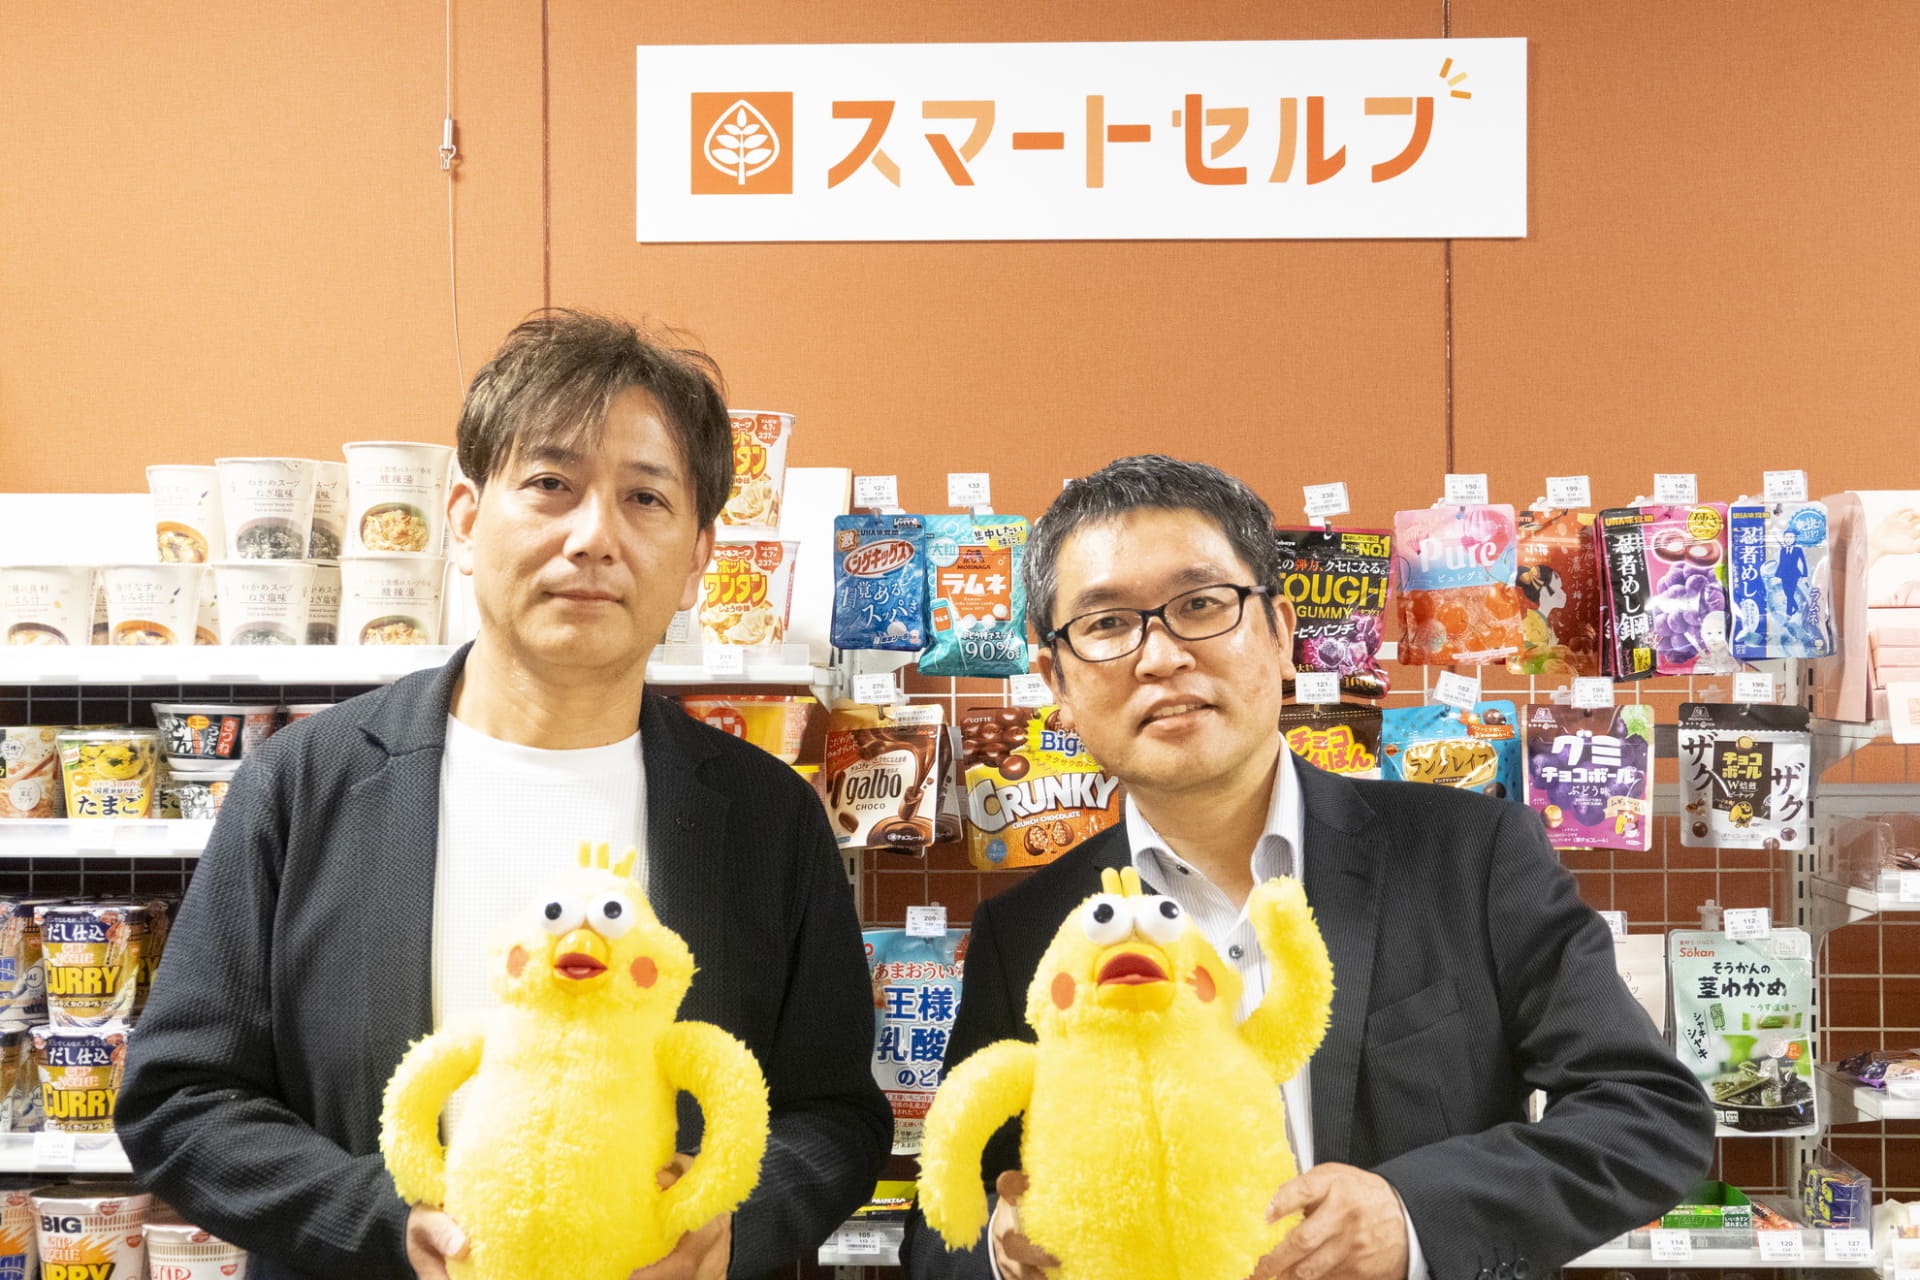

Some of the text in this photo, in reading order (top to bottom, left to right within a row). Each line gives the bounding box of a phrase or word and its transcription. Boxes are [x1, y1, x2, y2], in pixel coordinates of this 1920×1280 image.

[827, 93, 1434, 189] スマートセルフ
[718, 558, 751, 574] ホット
[1419, 538, 1497, 573] Pure
[1739, 526, 1759, 598] 忍者めし
[703, 574, 768, 606] ワンタン
[942, 573, 1007, 595] ラムネ
[1296, 605, 1353, 620] GUMMY
[220, 719, 236, 754] きつね
[1288, 728, 1350, 754] チョコ
[1551, 729, 1622, 767] グミ
[1722, 751, 1763, 766] チョコ
[1682, 731, 1719, 791] ザク
[1722, 765, 1763, 779] ボール
[1541, 766, 1637, 785] チョコボール
[846, 768, 903, 806] galbo
[1567, 785, 1611, 797] ぶどう味
[1770, 762, 1806, 822] ザク
[77, 794, 144, 815] たまご
[855, 802, 886, 811] CHOCO
[968, 772, 1120, 834] CRUNKY
[47, 923, 107, 941] だし仕込
[44, 959, 120, 995] CURRY
[1711, 962, 1772, 975] そうかんの
[1697, 976, 1788, 999] 茎わかめ
[49, 1047, 111, 1065] だし仕込
[40, 1215, 82, 1233] BIG
